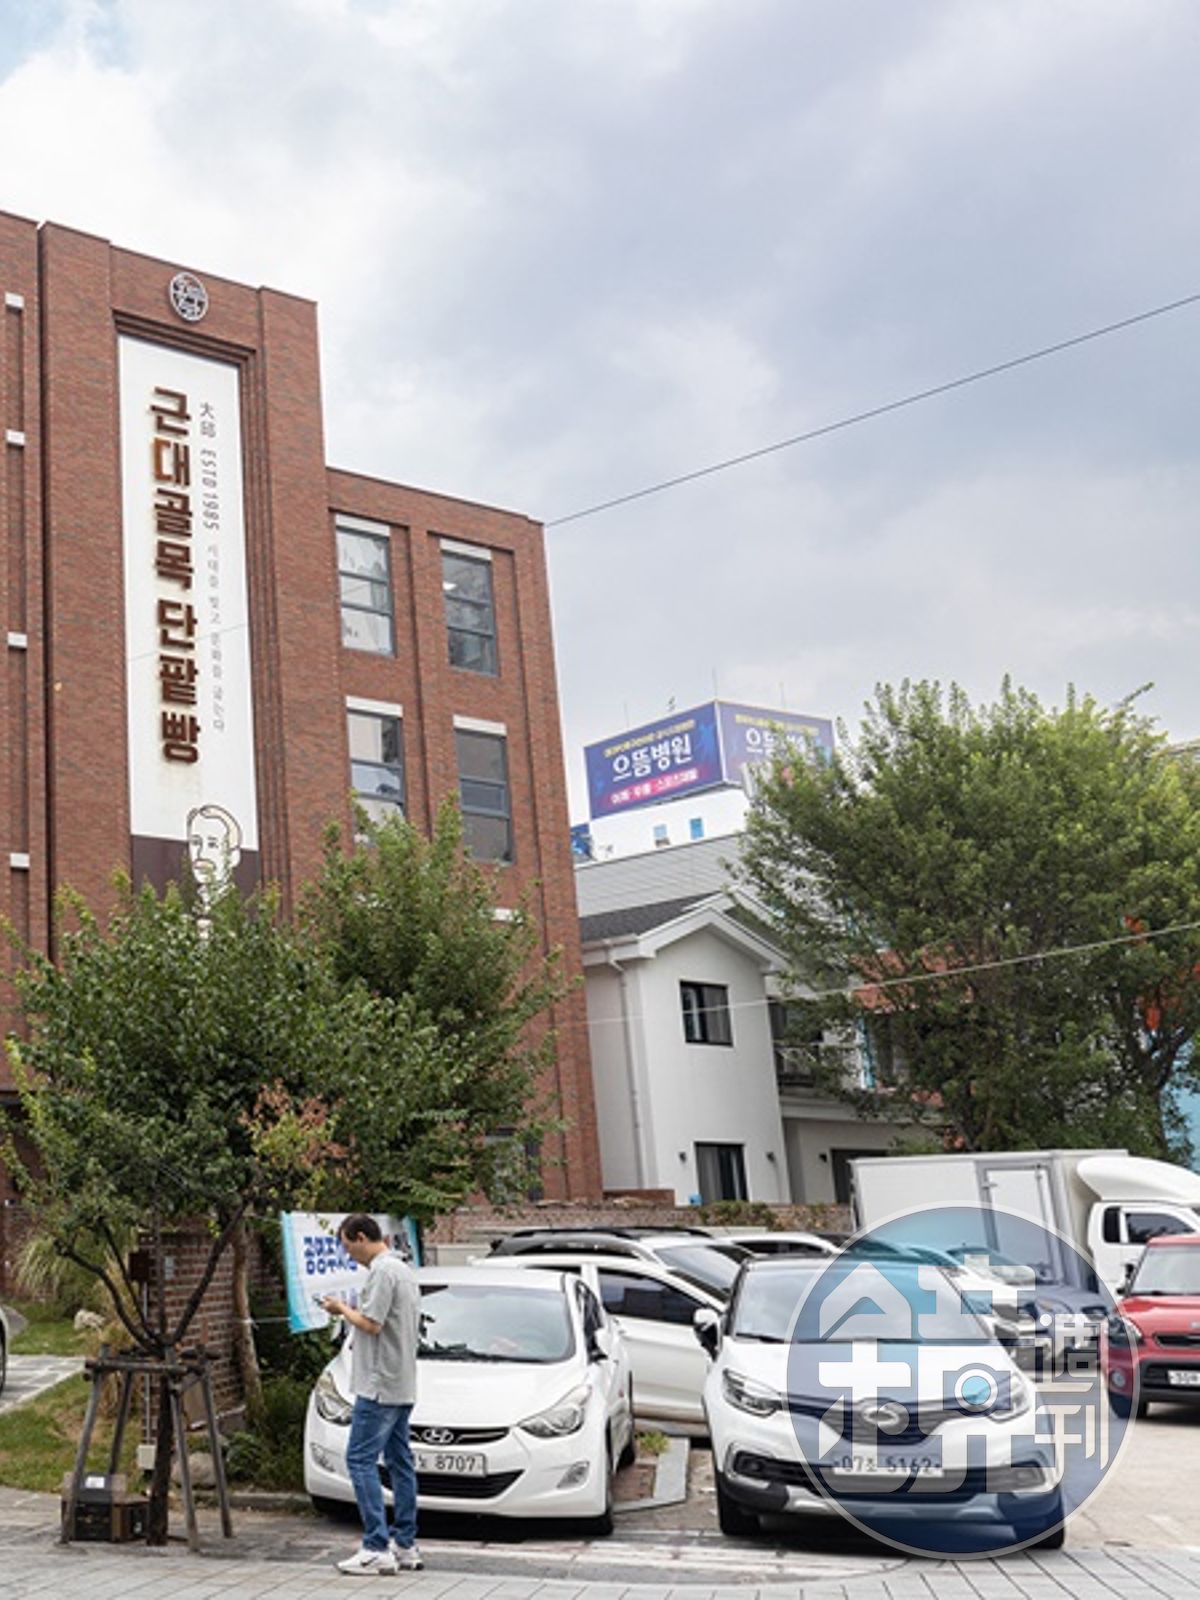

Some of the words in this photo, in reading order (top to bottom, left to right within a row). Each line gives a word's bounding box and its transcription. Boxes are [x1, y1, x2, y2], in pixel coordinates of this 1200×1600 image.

[151, 386, 193, 590] 근대골목
[157, 598, 200, 764] 단팥빵
[611, 732, 693, 783] 으뜸병원
[435, 1455, 477, 1472] 8707
